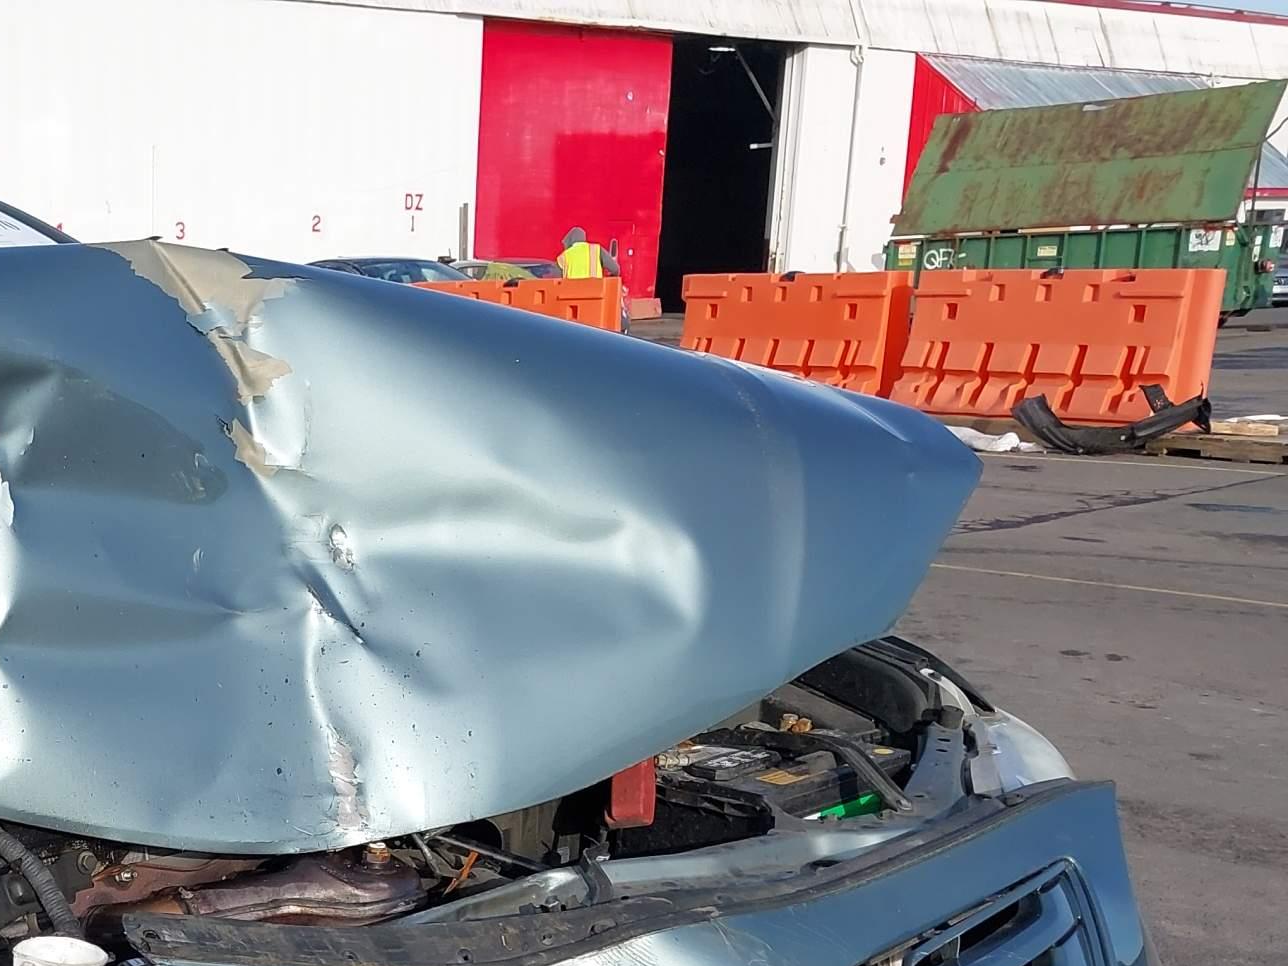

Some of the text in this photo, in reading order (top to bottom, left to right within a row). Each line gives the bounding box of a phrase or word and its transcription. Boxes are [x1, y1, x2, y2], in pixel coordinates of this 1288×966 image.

[404, 193, 423, 211] DZ
[175, 221, 186, 240] 3
[312, 215, 321, 232] 2
